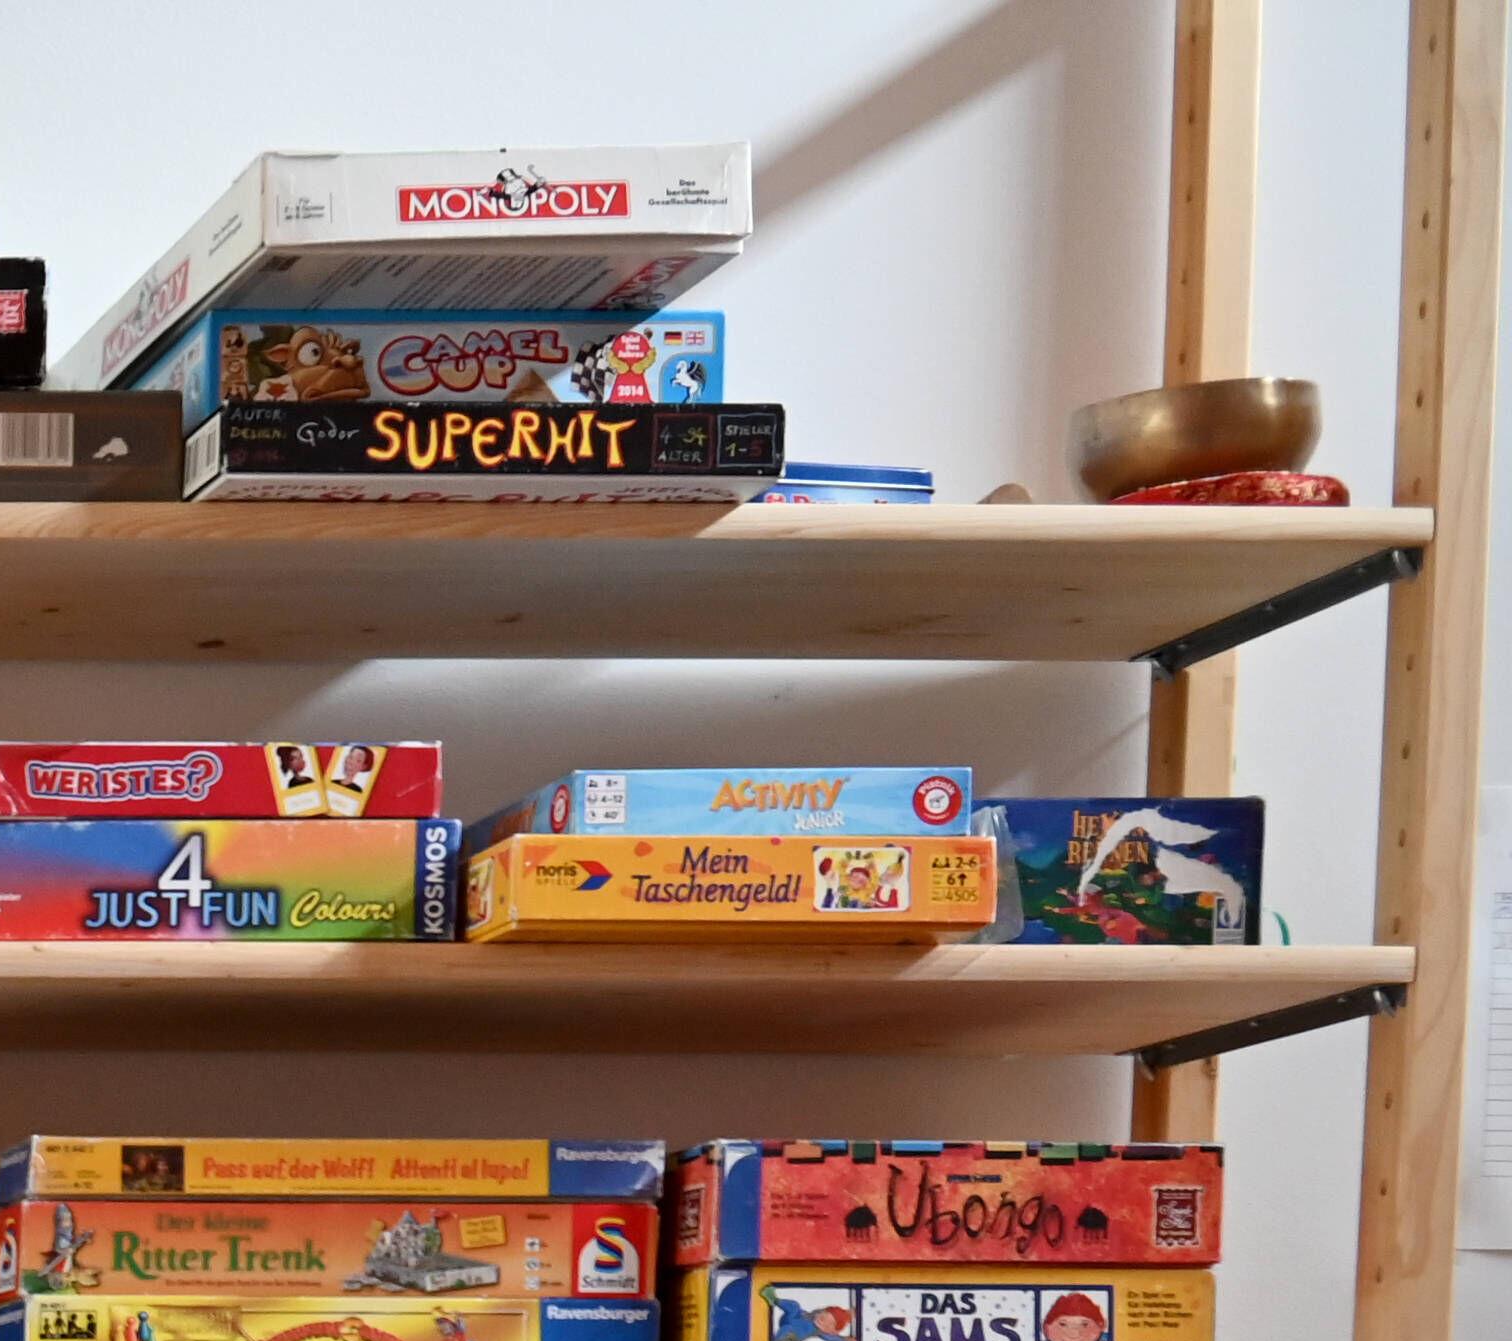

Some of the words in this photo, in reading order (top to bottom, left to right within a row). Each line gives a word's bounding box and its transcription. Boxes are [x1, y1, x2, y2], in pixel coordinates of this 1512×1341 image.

[367, 409, 636, 468] SUPERHIT
[536, 864, 577, 880] noris
[680, 848, 748, 876] Mein
[425, 828, 447, 934] KOSMOS
[633, 873, 801, 904] Taschengeld!
[86, 892, 185, 927] JUST
[202, 891, 277, 926] FUN
[291, 891, 396, 924] Colours
[113, 1234, 214, 1278] Ritter
[221, 1234, 326, 1273] Trenk
[920, 1293, 976, 1315] DAS
